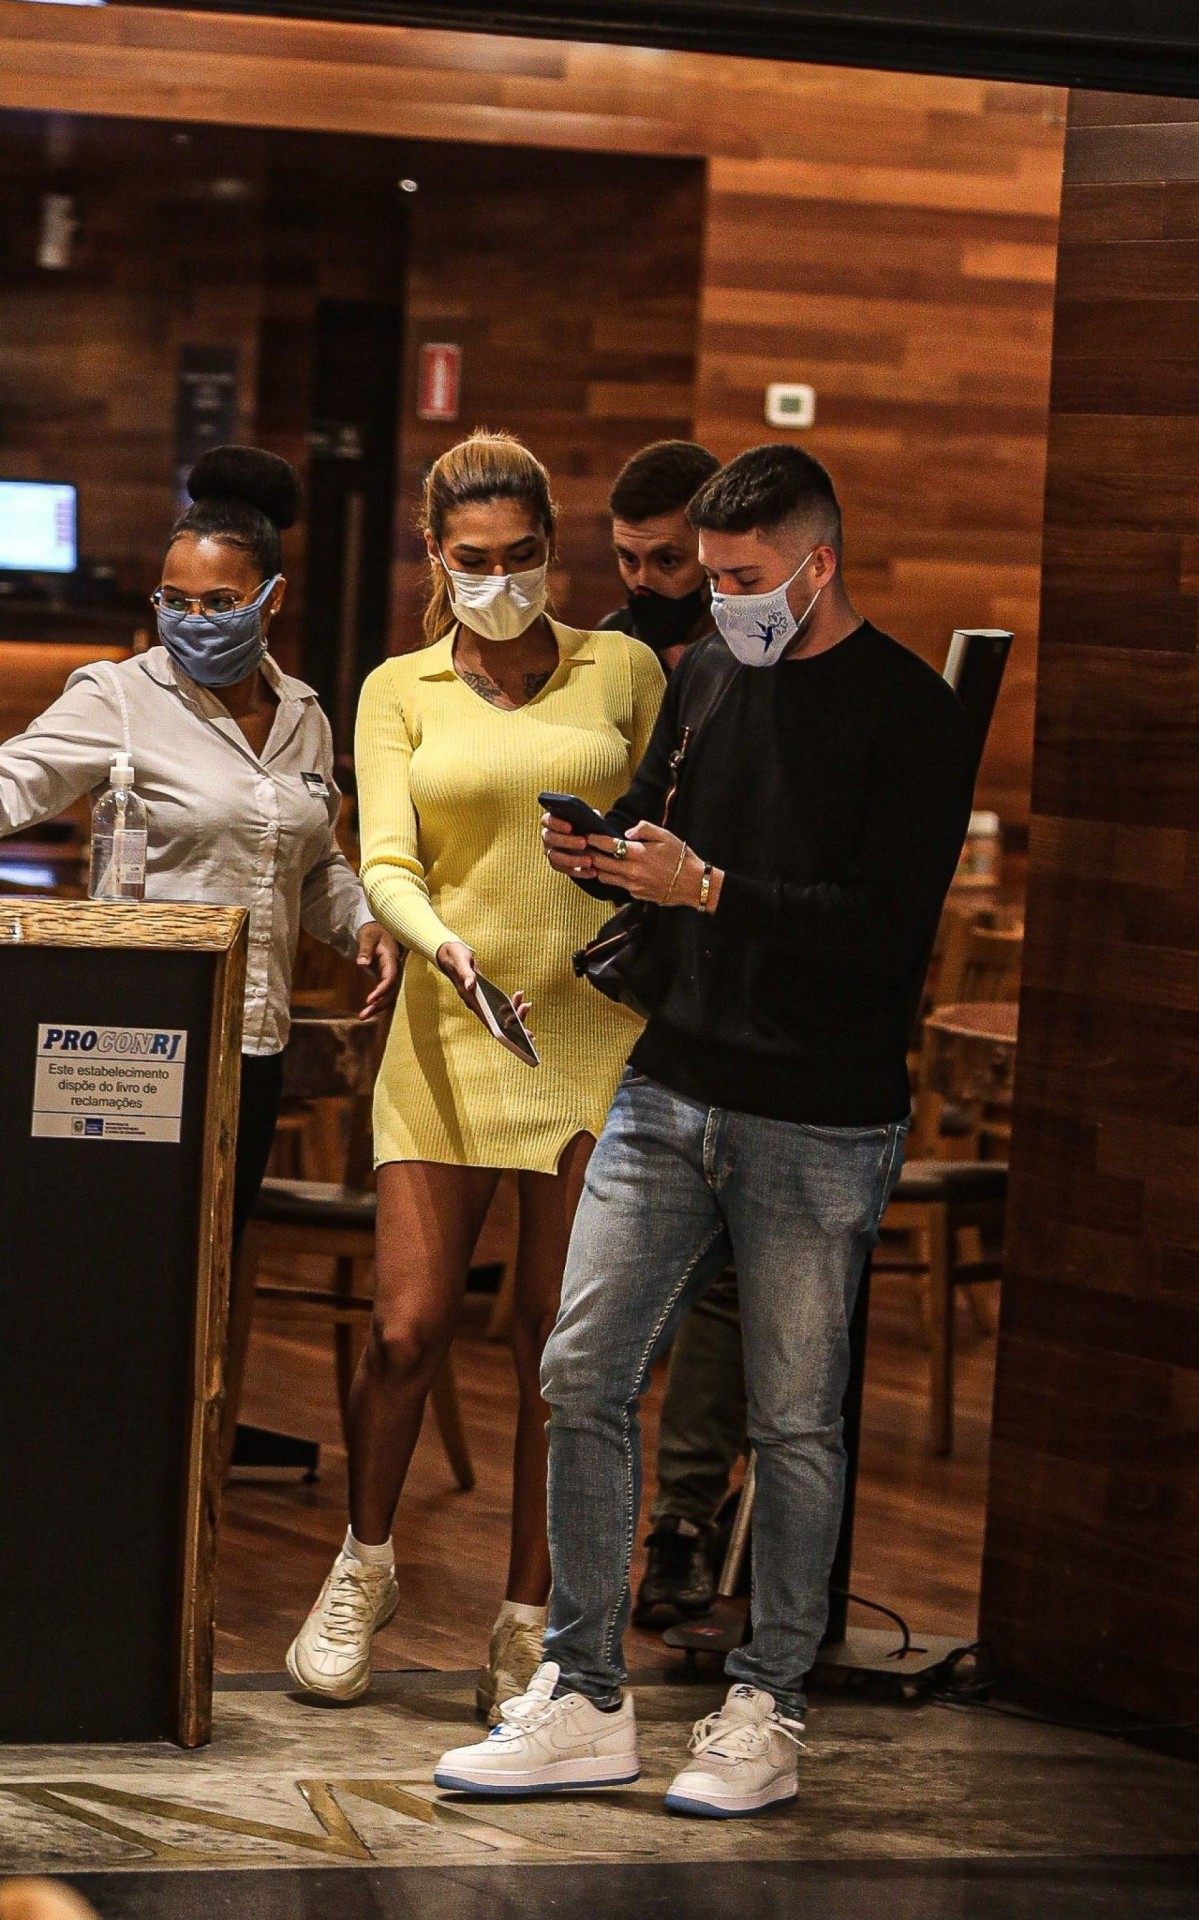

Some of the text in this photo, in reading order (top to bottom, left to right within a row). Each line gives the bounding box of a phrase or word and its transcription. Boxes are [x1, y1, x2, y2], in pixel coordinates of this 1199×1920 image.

[48, 1063, 170, 1079] Este estabelecimento
[58, 1079, 158, 1094] dispõe do livro de
[70, 1096, 143, 1110] reclamações
